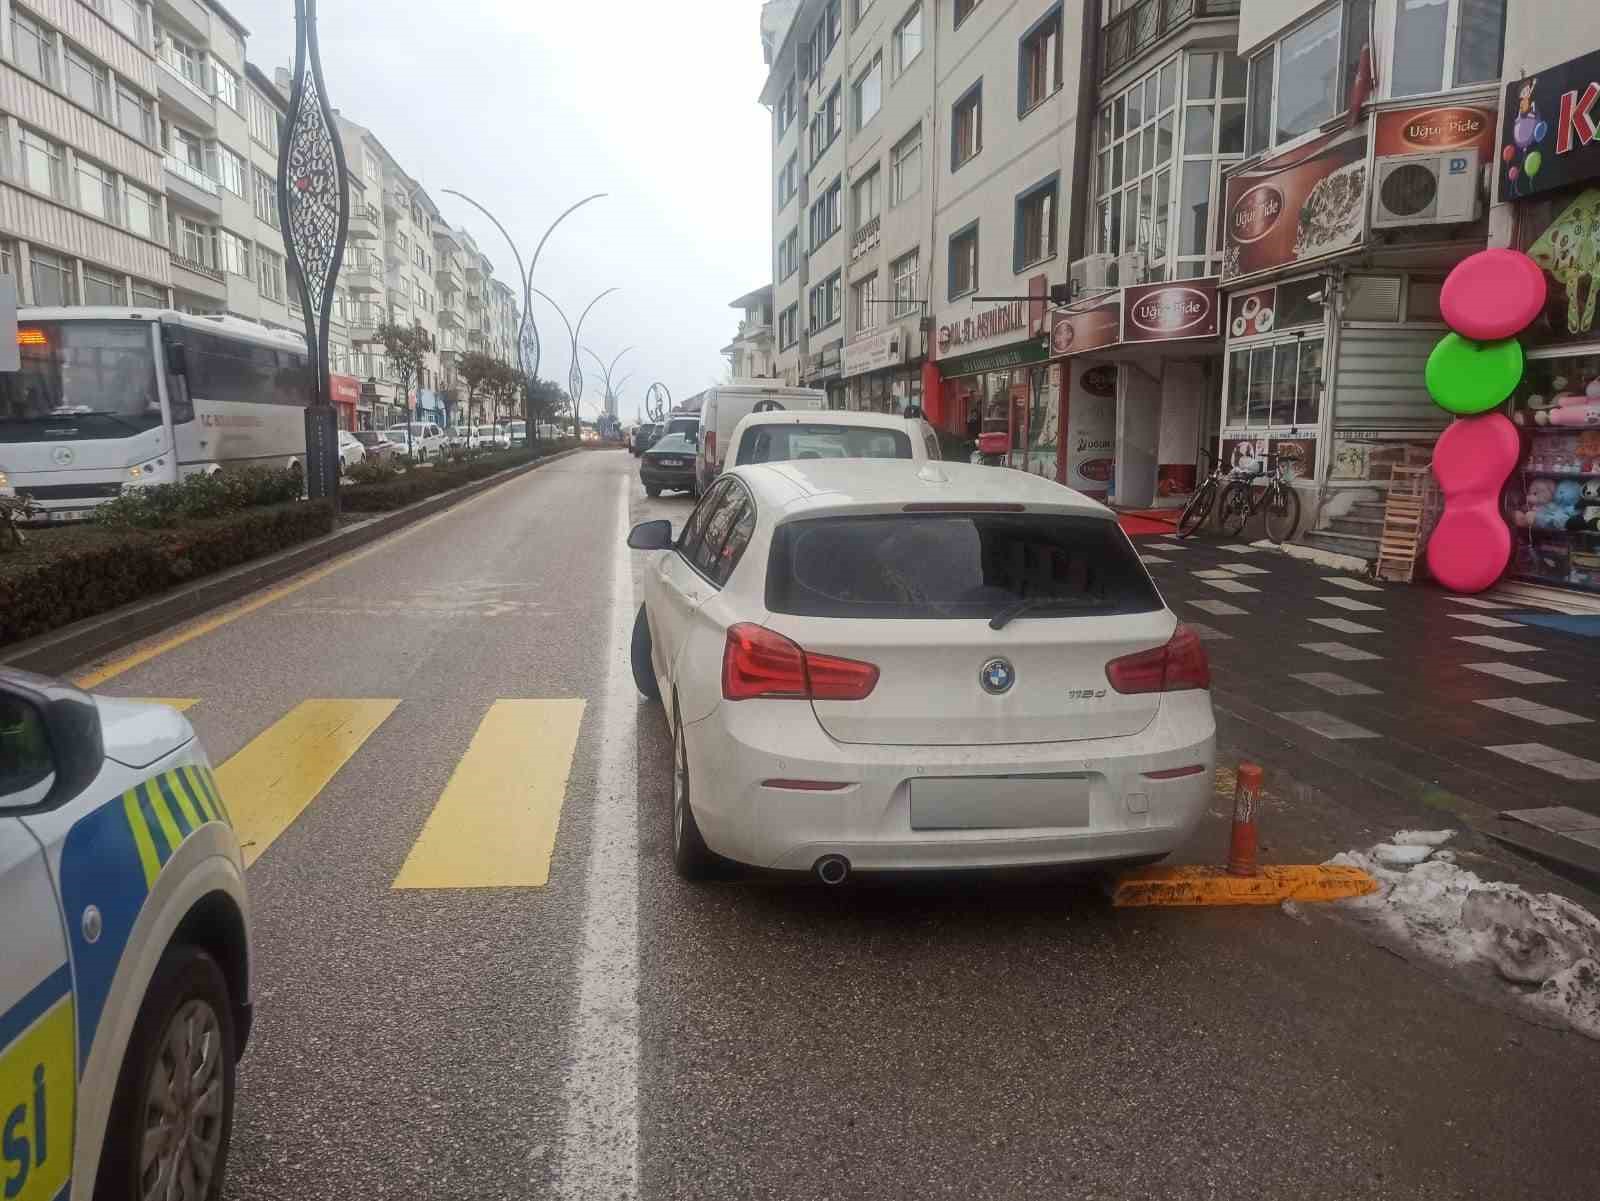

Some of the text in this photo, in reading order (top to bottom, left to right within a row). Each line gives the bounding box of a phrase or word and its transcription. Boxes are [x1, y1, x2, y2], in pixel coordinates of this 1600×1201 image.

[1448, 118, 1481, 134] Pide
[1556, 82, 1600, 154] K
[1140, 303, 1170, 320] Uğ
